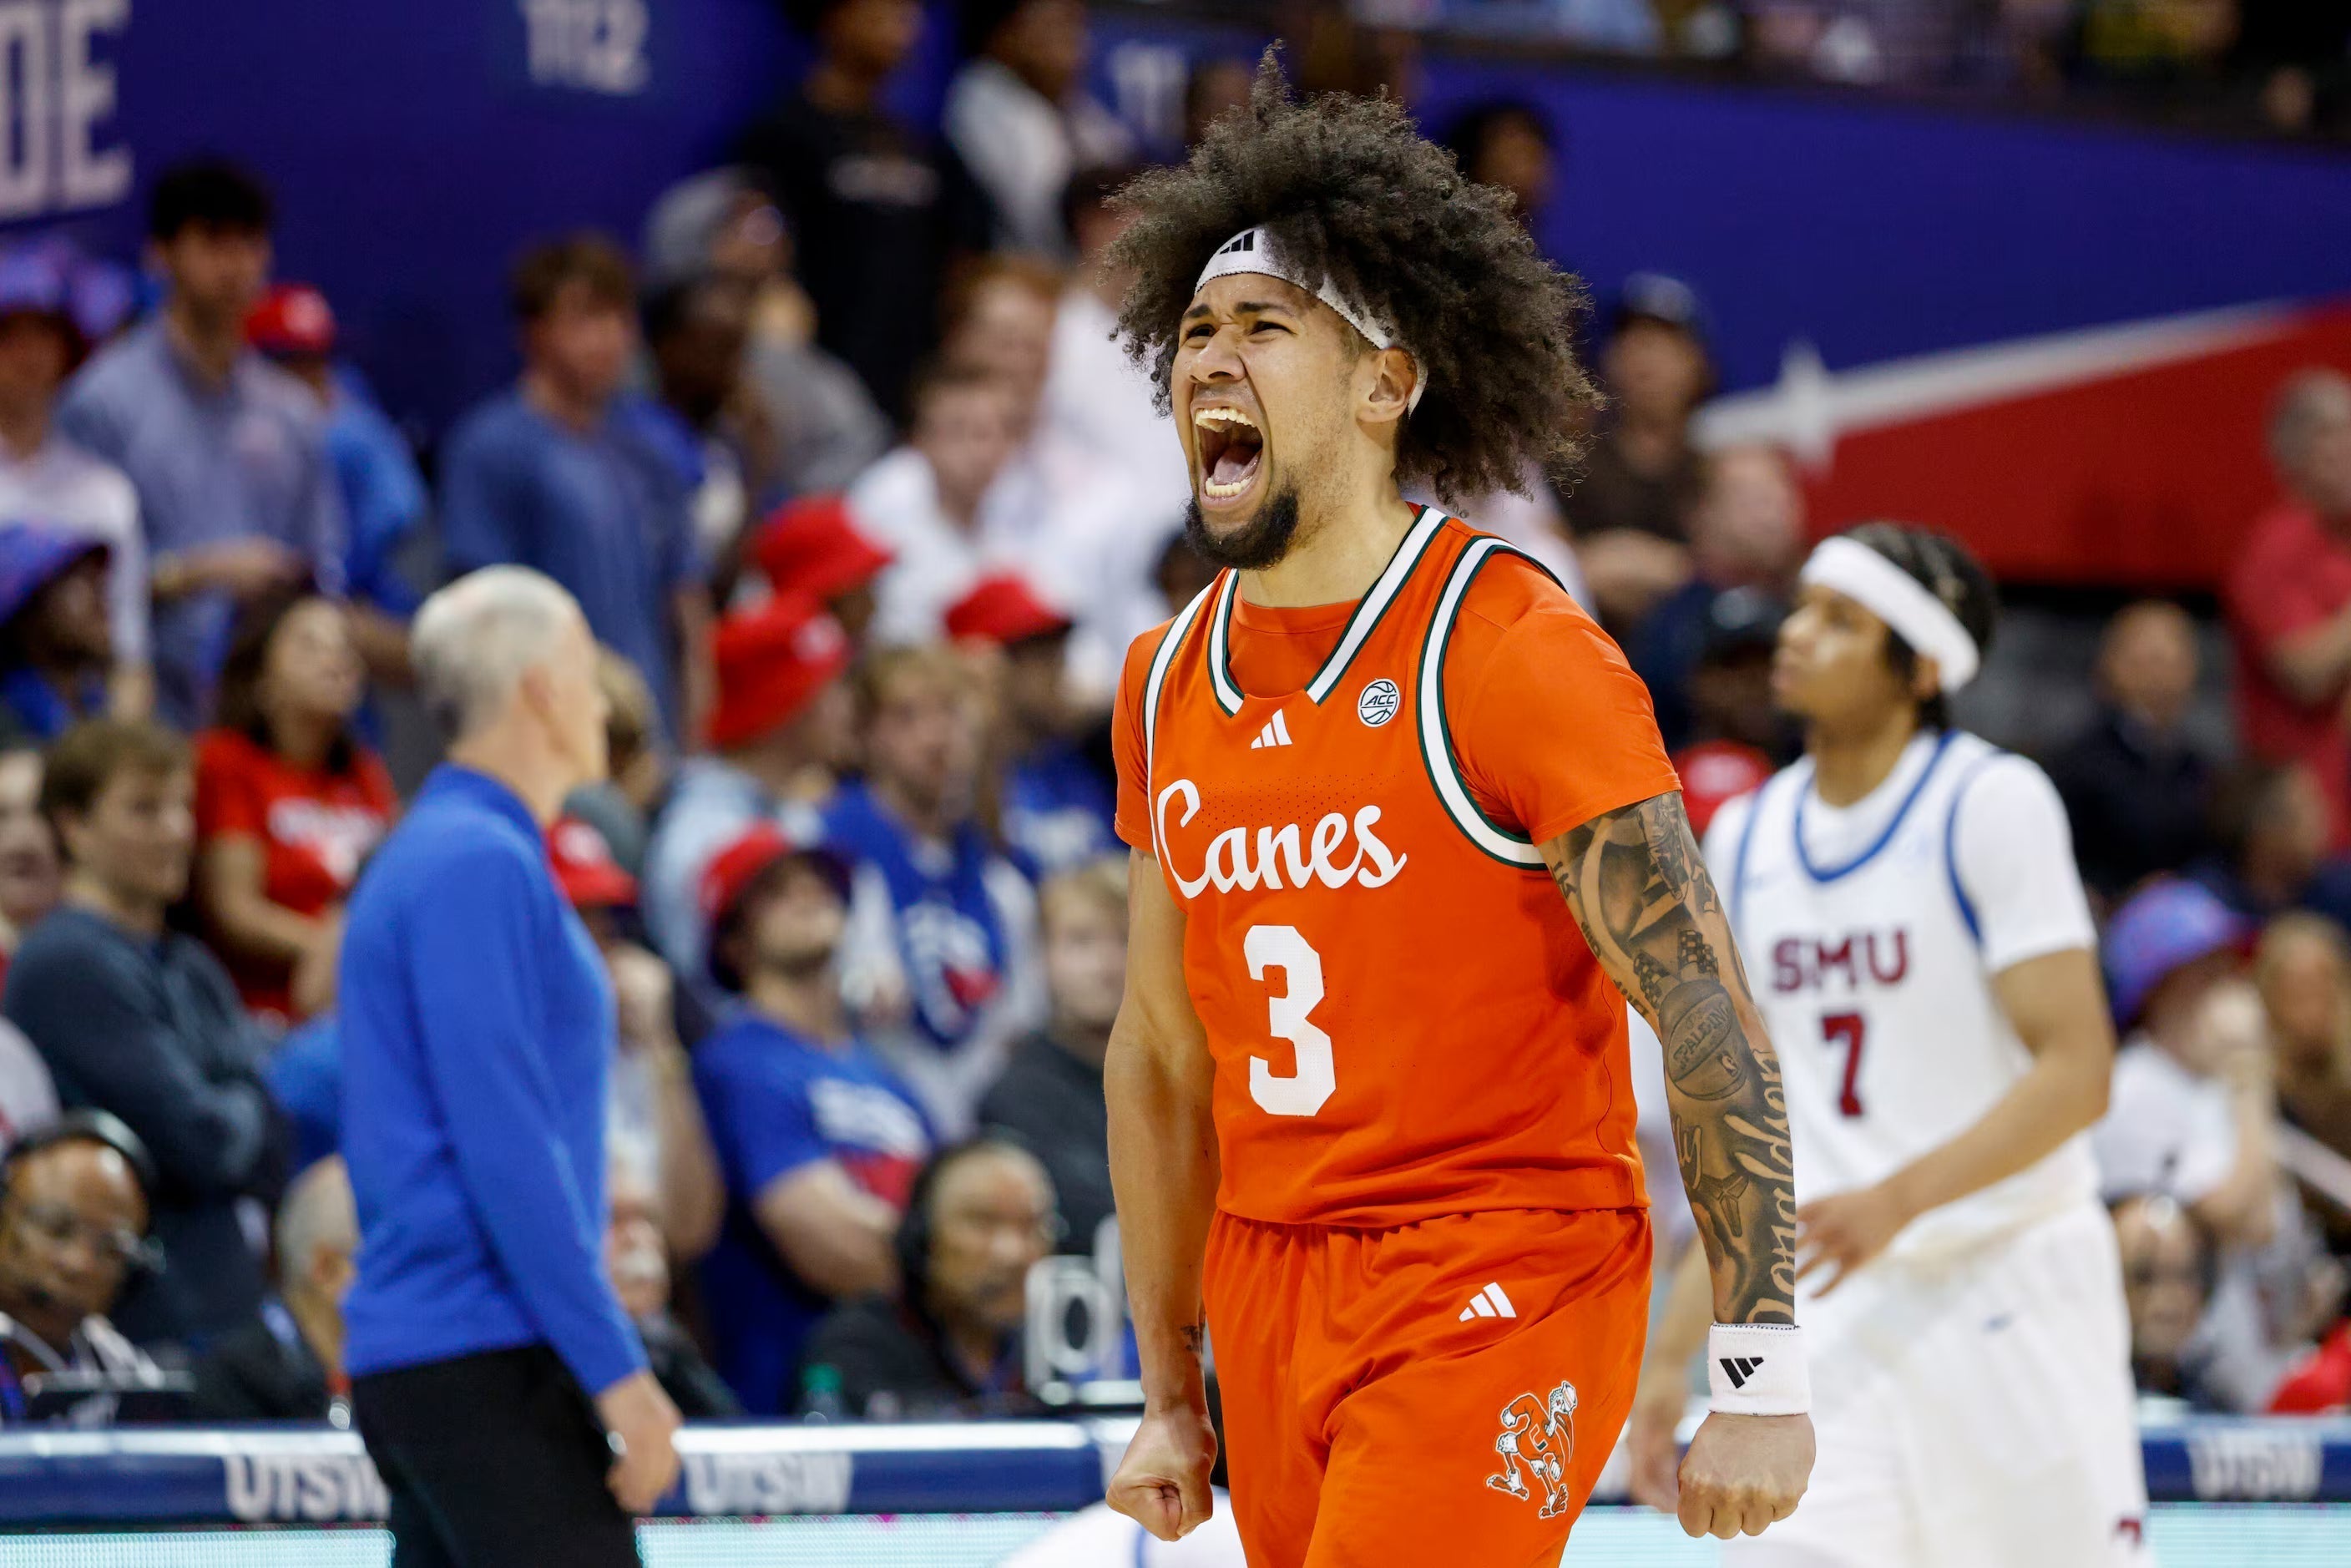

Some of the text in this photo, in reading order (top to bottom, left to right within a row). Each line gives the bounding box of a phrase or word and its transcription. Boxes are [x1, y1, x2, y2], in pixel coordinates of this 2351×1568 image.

[1364, 694, 1398, 706] ACC
[1157, 779, 1408, 899] Canes
[1771, 927, 1910, 994] SMU
[1243, 924, 1337, 1117] 3
[1821, 1011, 1866, 1120] 7
